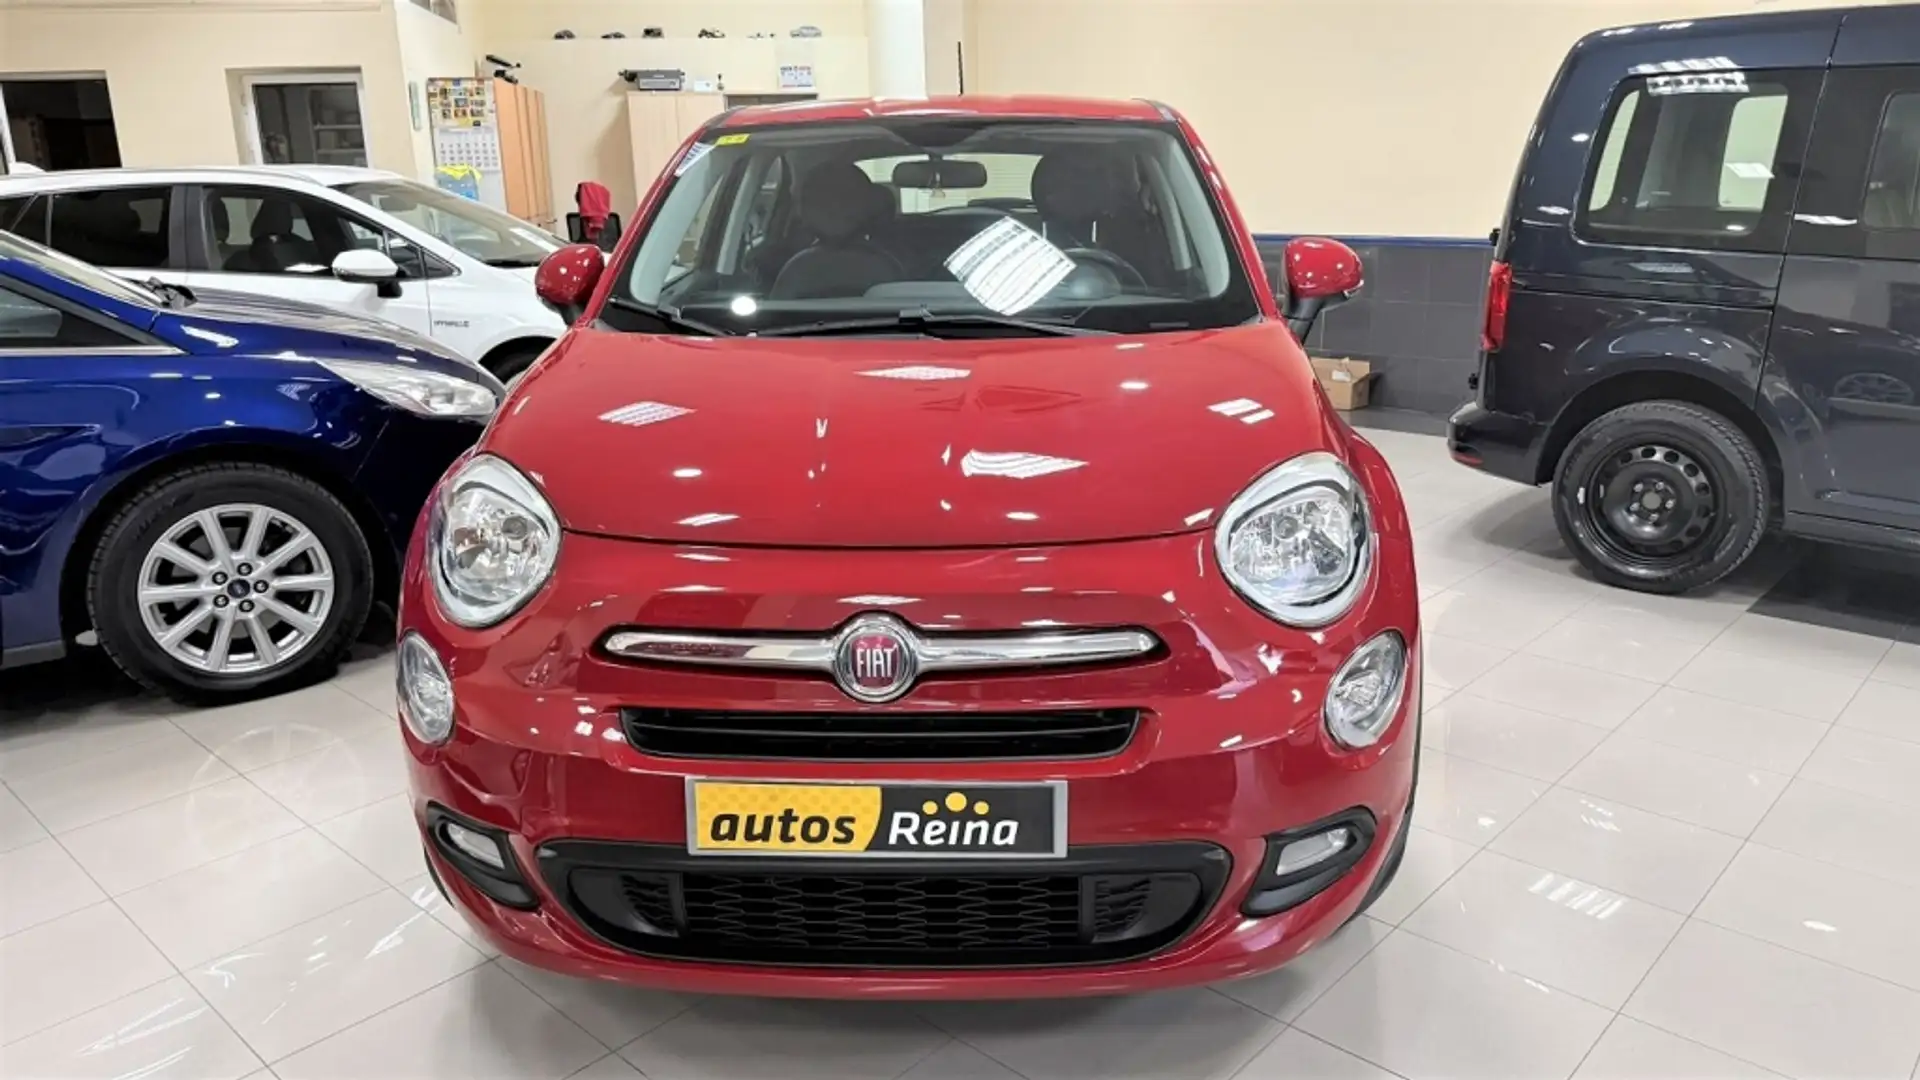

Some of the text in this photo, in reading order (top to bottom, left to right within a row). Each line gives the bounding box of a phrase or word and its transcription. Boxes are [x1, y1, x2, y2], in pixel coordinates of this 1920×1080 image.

[856, 643, 898, 678] FIAT
[710, 808, 1019, 846] autos Reina
